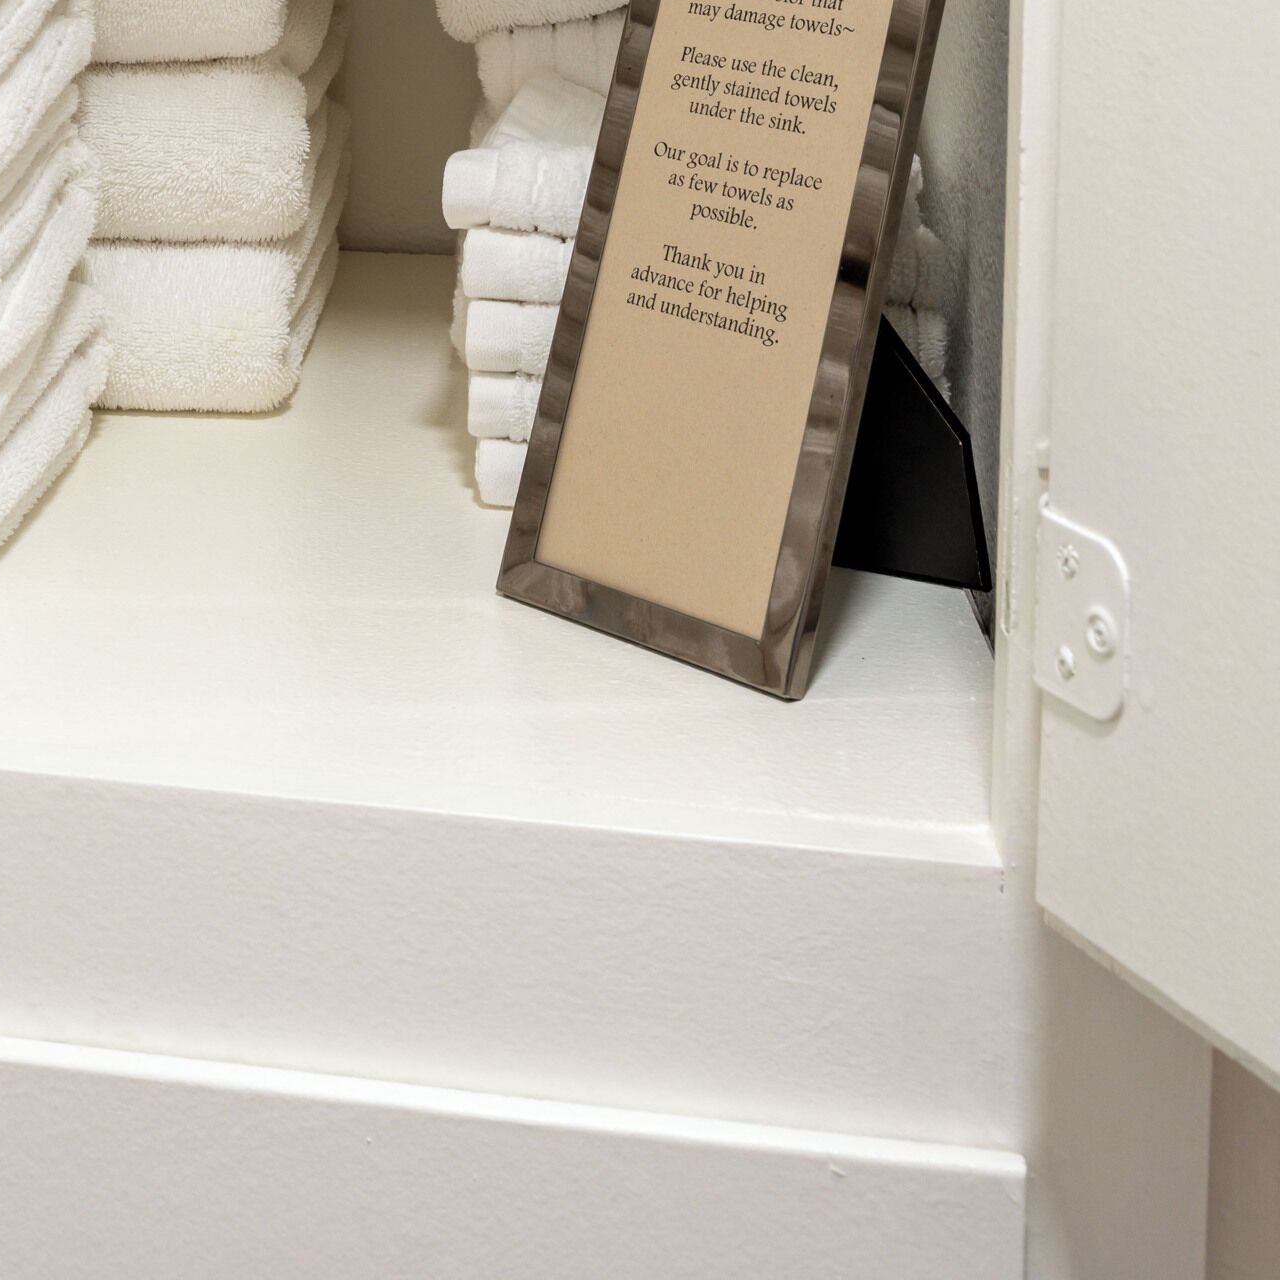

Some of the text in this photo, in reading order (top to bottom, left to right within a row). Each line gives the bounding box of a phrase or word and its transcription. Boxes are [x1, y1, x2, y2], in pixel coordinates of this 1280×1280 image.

[687, 2, 722, 22] may
[723, 3, 786, 31] damage
[680, 46, 839, 93] Please use the clean,
[670, 73, 837, 114] gently stained towels
[689, 100, 806, 135] under the sink.
[653, 141, 823, 191] Our goal is to replace
[667, 173, 795, 211] as few towels as
[689, 203, 757, 230] possible.
[663, 244, 766, 286] Thank you in
[630, 264, 788, 323] advance for helping
[626, 292, 779, 347] and understanding.
